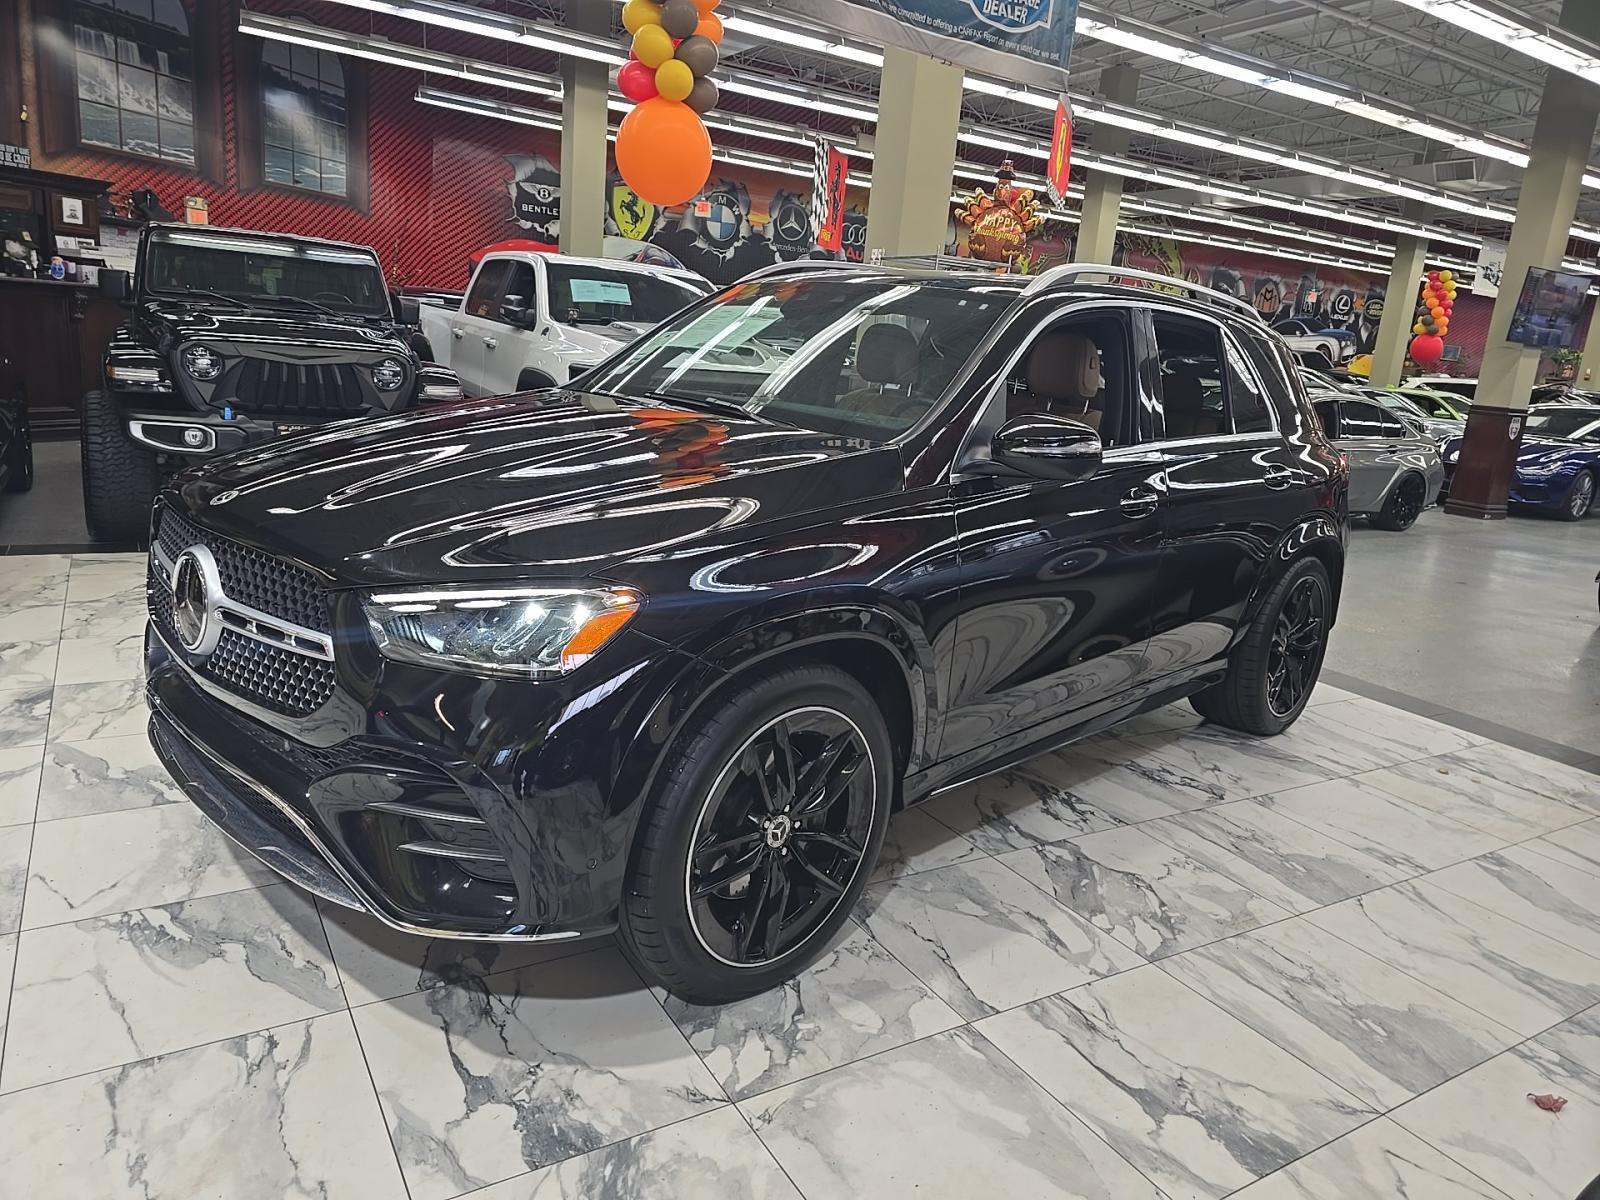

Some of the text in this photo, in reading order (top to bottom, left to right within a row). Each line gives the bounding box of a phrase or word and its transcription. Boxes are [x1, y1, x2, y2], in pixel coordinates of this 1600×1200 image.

[983, 0, 1028, 24] DEALER
[898, 8, 926, 24] committed
[926, 16, 932, 25] to
[932, 18, 953, 33] offering
[958, 25, 982, 38] CARFAX
[983, 31, 998, 43] Report
[522, 203, 559, 216] BENTLE
[984, 214, 1018, 230] HAPPY
[847, 245, 864, 261] Au
